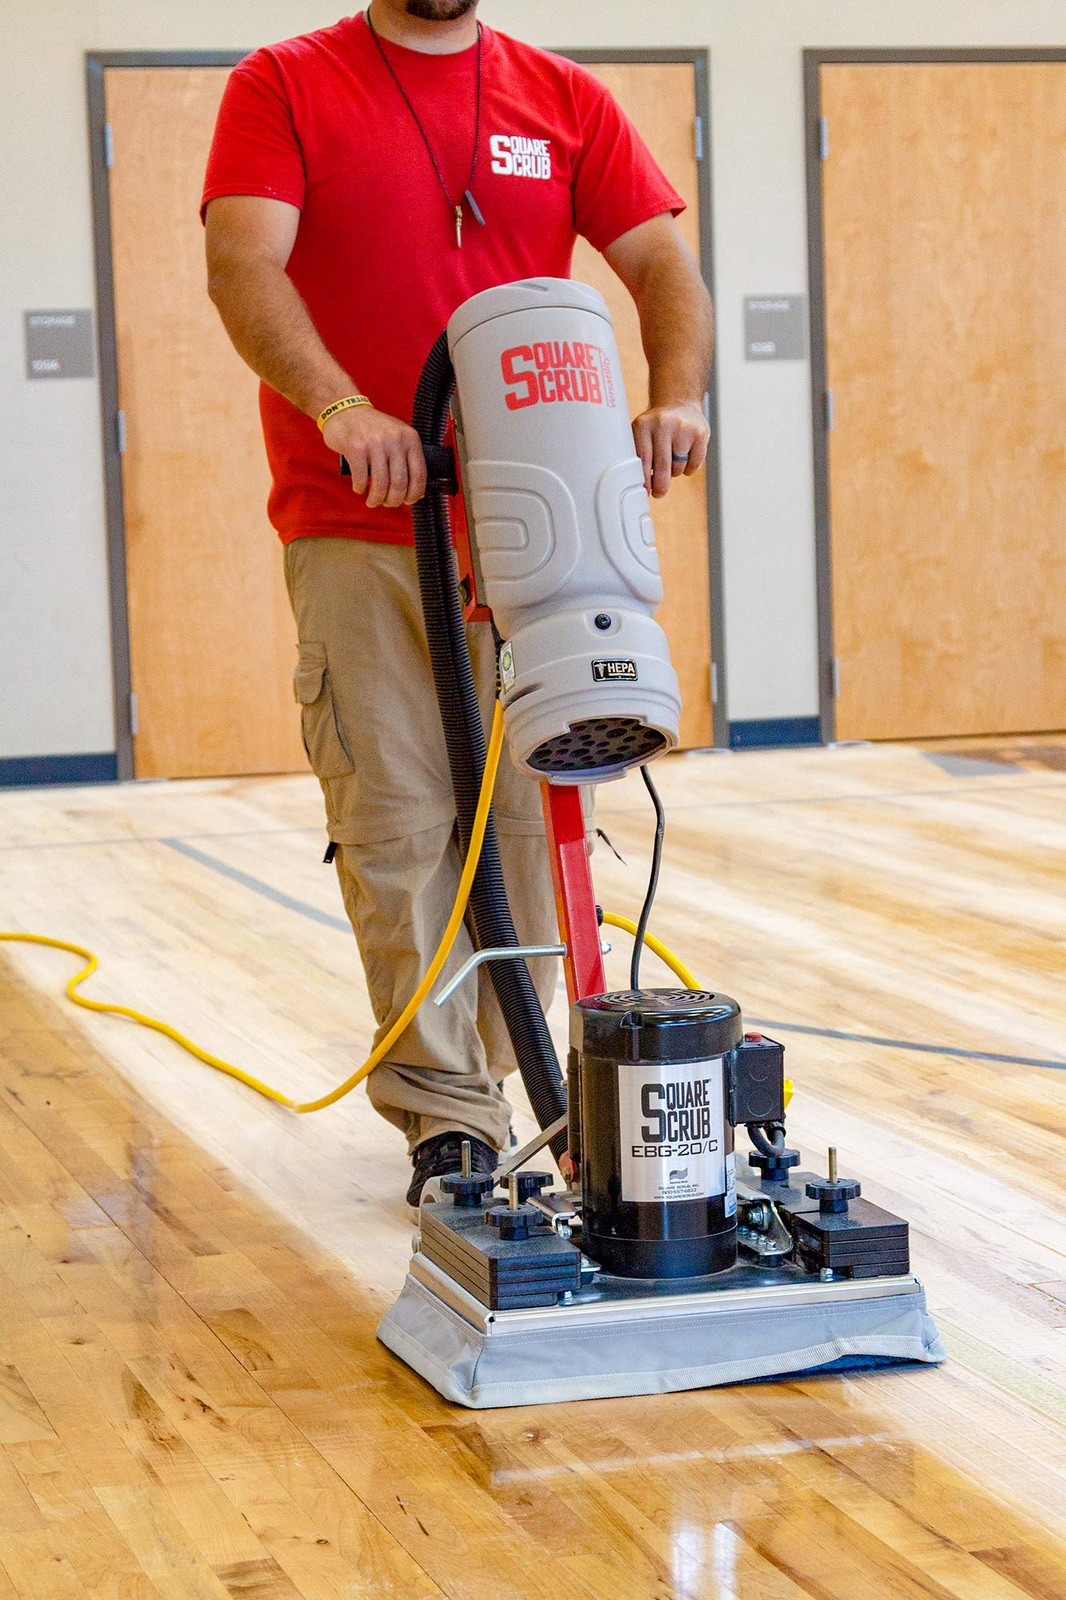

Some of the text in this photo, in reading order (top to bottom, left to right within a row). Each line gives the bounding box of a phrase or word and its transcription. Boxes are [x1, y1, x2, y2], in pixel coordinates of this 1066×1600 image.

[321, 401, 345, 420] DON'T
[607, 662, 635, 674] HEPA
[631, 1140, 718, 1158] EBG-20/C
